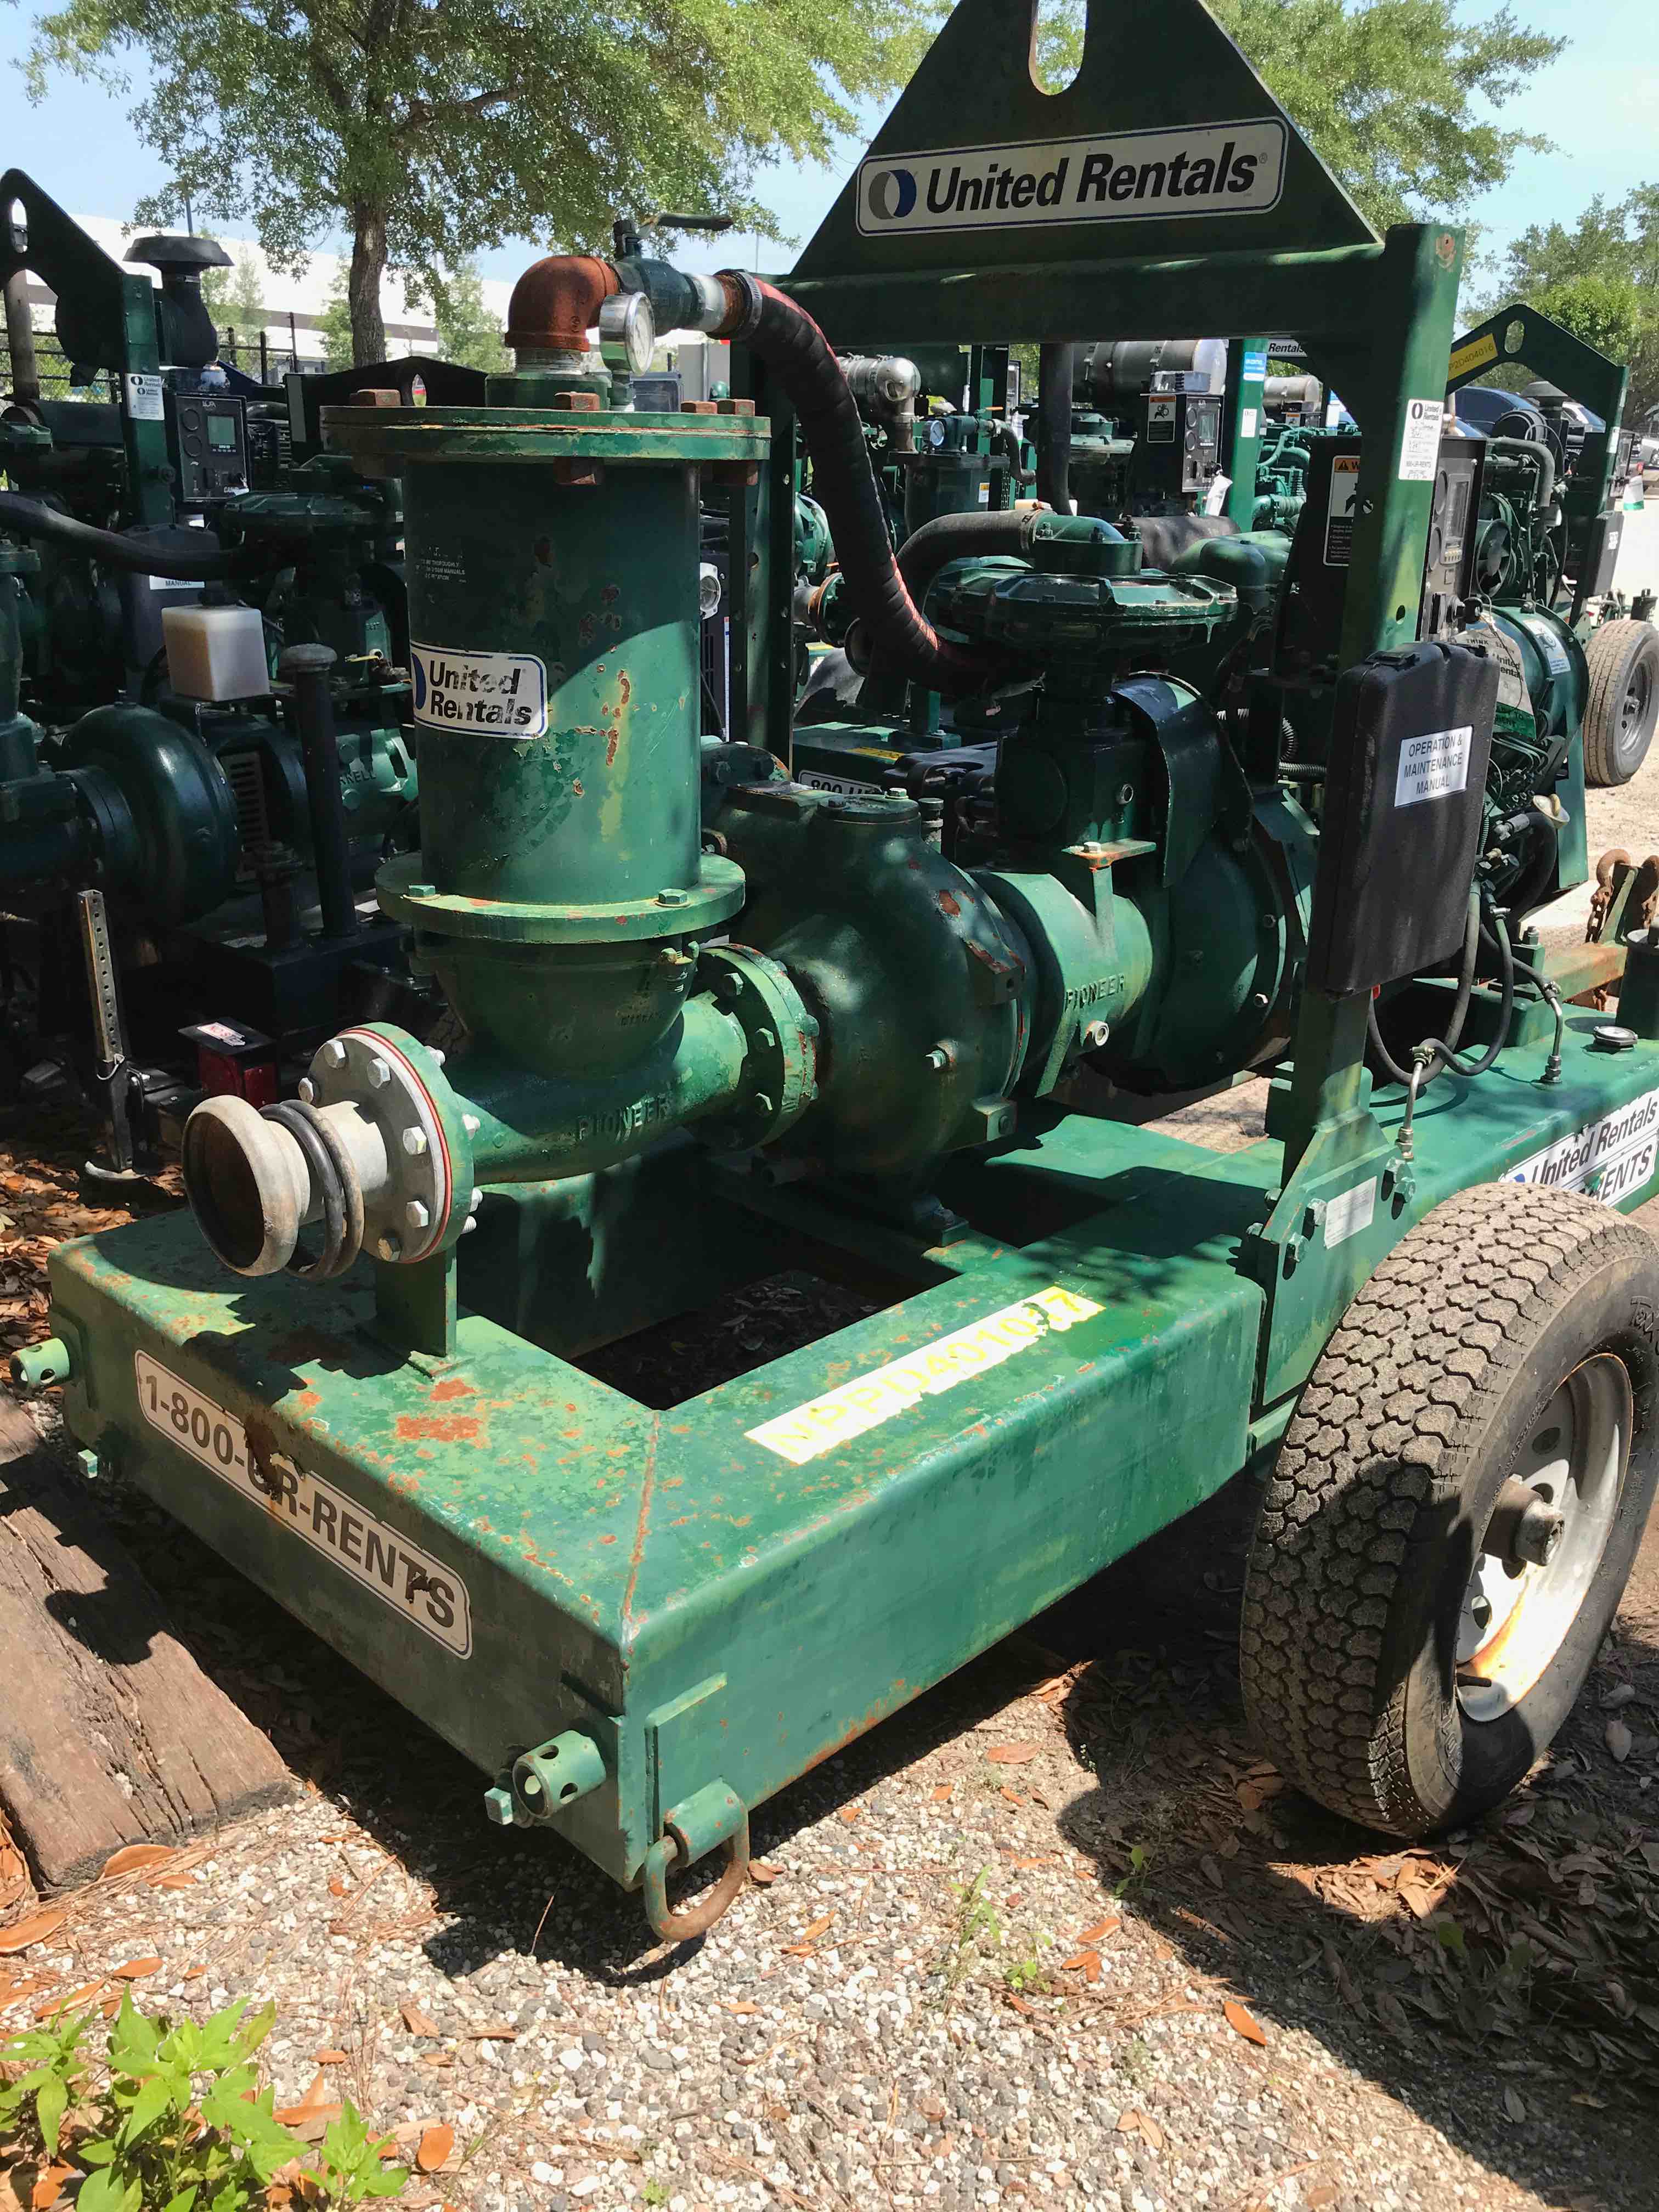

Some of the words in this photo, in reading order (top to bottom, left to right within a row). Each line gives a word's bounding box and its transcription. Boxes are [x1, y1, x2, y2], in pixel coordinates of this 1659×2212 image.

[927, 158, 1069, 213] United
[1077, 142, 1257, 203] Rentals
[429, 660, 521, 695] United
[431, 690, 532, 725] Rentals
[1408, 738, 1455, 758] OPERATION
[1457, 735, 1463, 744] &
[1404, 753, 1463, 778] MAINTENANCE
[1416, 776, 1450, 795] MANUAL
[1064, 973, 1125, 1012] PIONEER
[578, 1093, 668, 1140] PIONEER
[1596, 1097, 1658, 1155] Rentals
